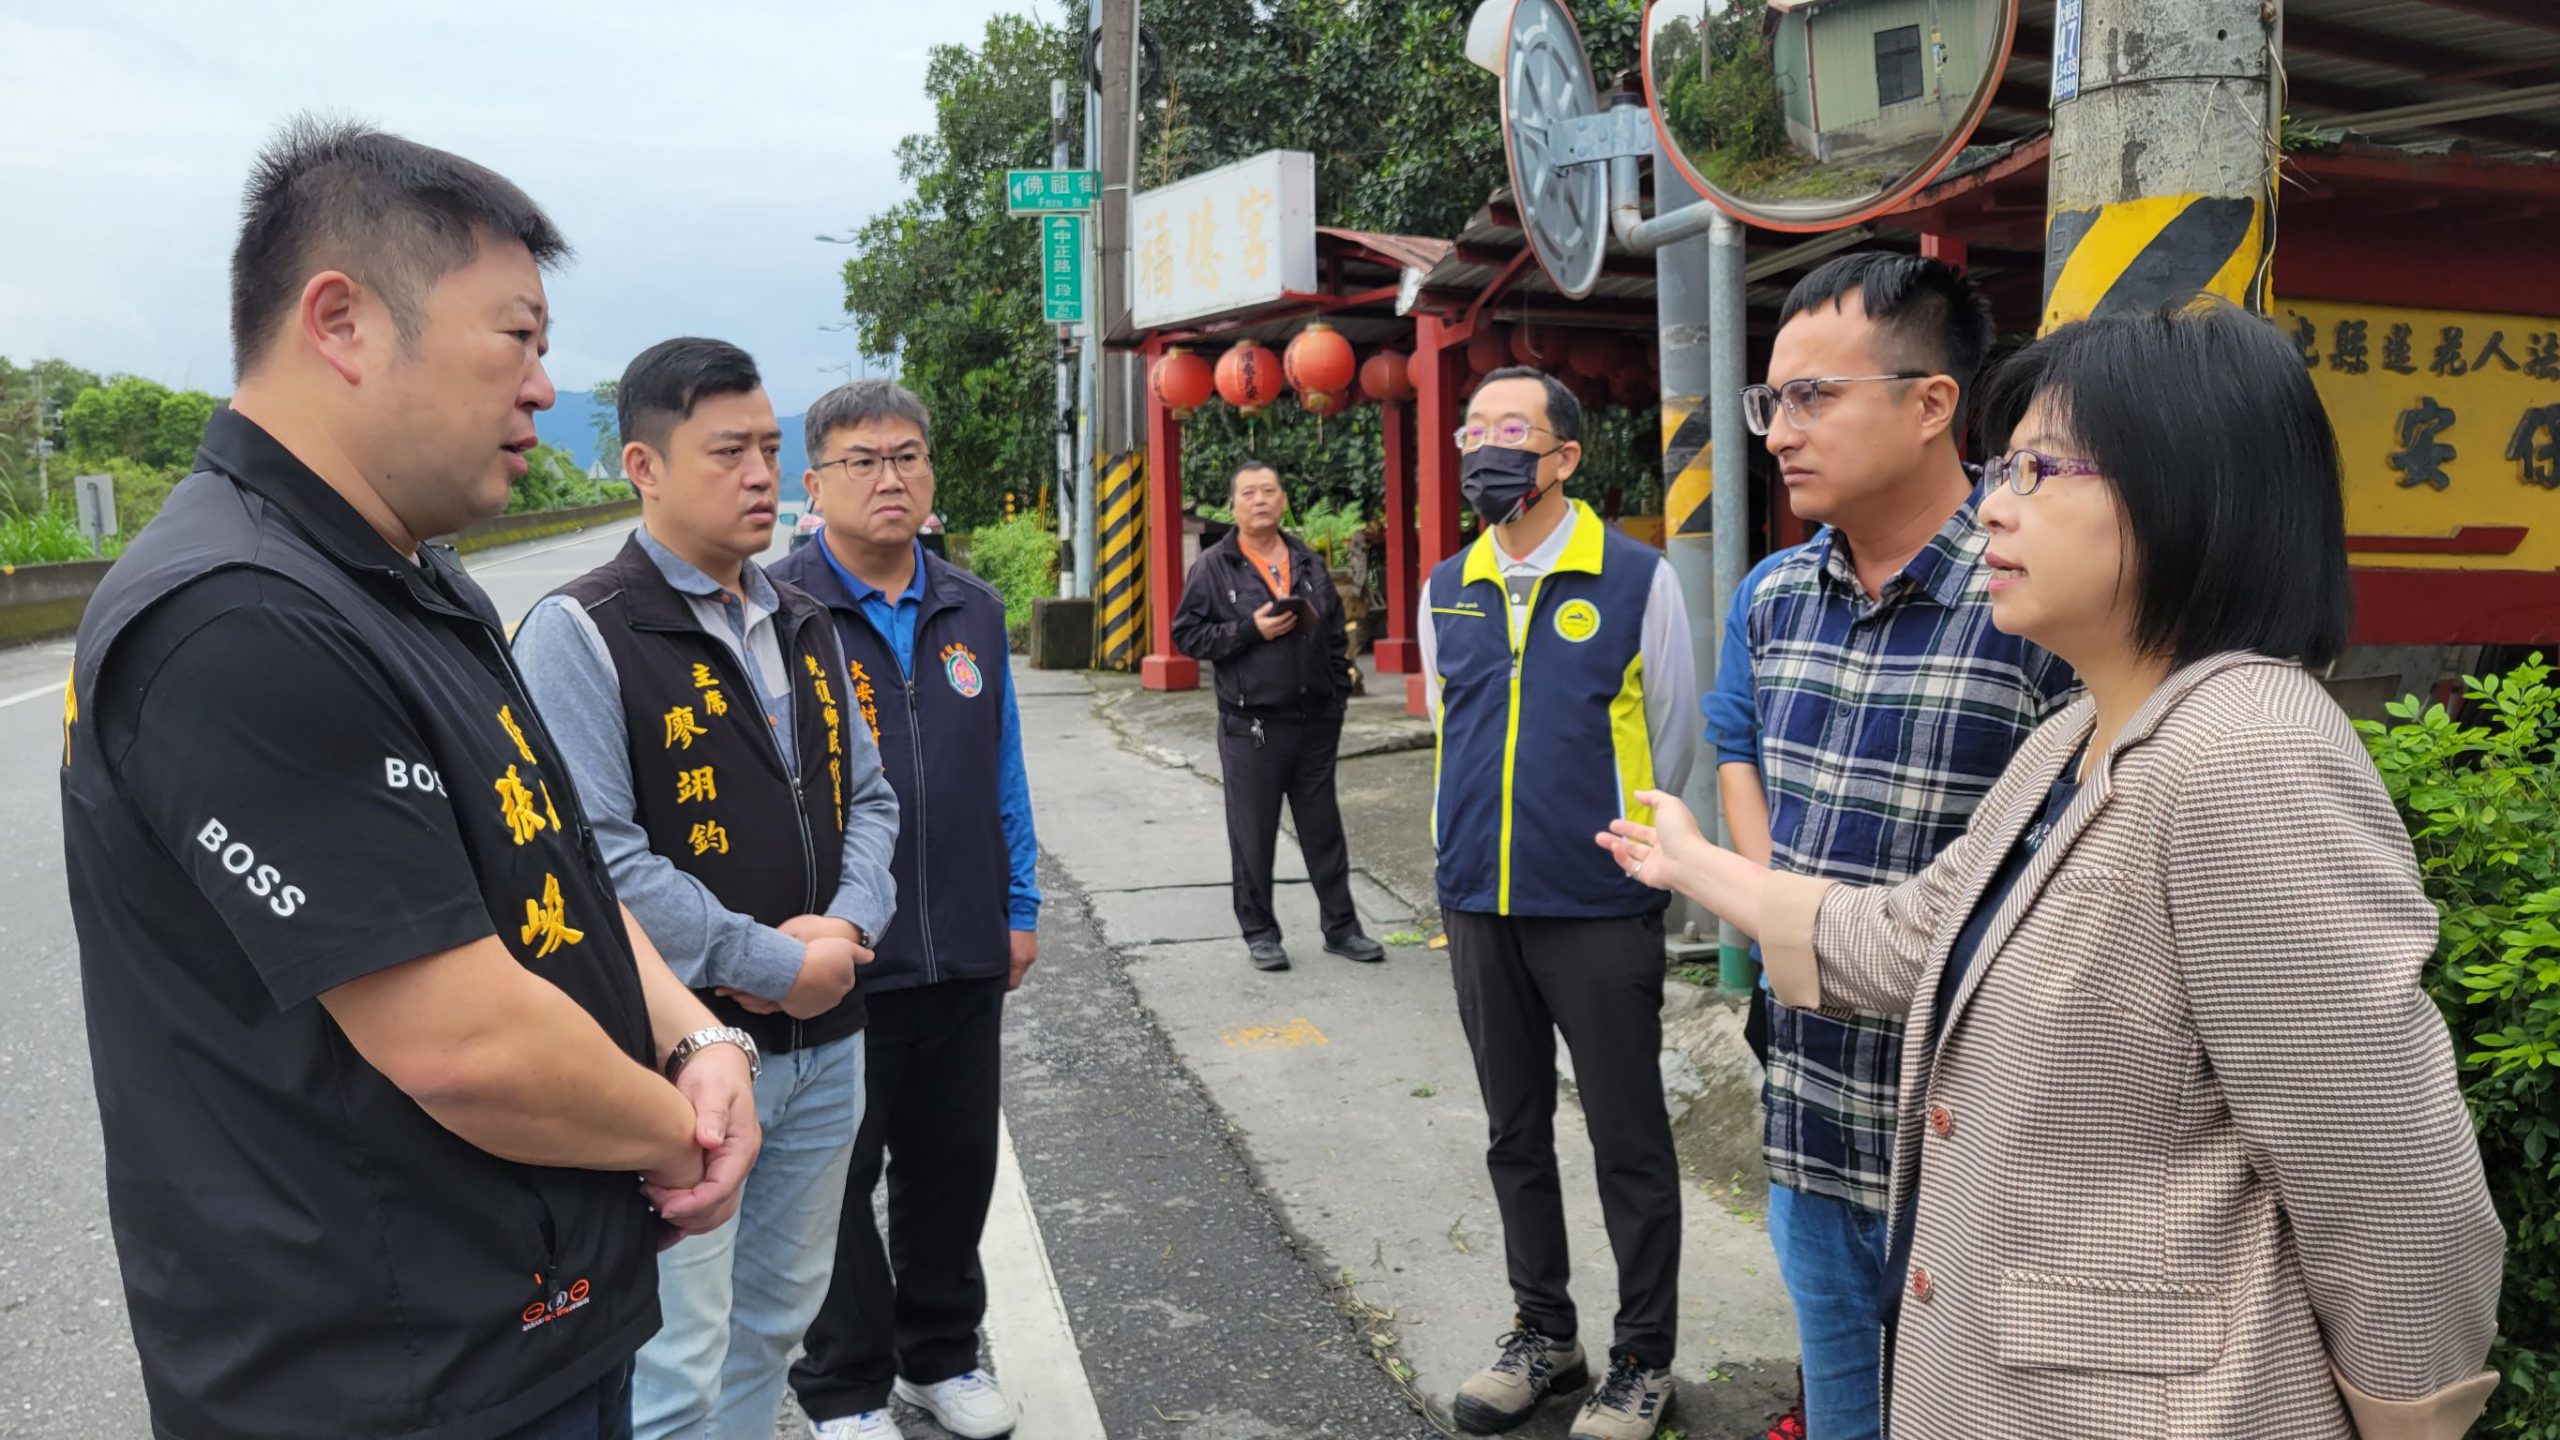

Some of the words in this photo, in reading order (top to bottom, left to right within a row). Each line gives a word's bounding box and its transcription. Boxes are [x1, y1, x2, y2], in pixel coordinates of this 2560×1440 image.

[1023, 174, 1097, 196] 佛祖街
[1053, 229, 1073, 297] 中正路一段
[1141, 185, 1273, 299] 福德宮
[692, 663, 728, 717] 主席
[663, 705, 730, 857] 廖翊鈞
[196, 817, 307, 917] BOSS
